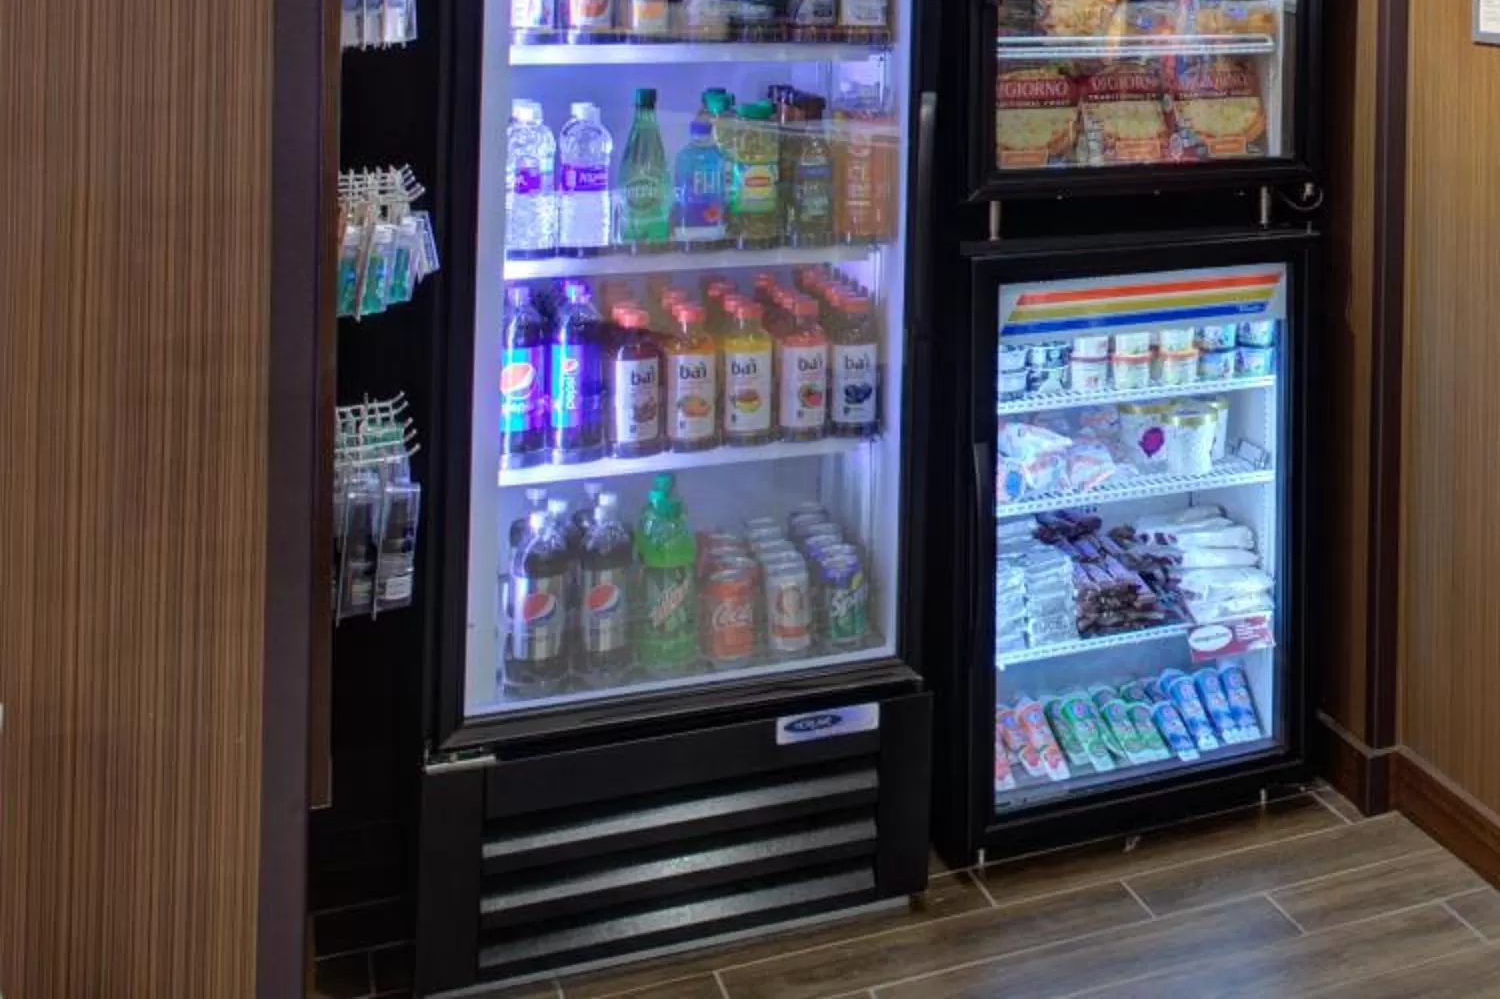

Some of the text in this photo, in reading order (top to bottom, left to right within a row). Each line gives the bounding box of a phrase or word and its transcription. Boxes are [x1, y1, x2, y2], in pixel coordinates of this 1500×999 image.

[680, 361, 707, 380] bai
[731, 357, 757, 376] bai
[844, 352, 870, 371] bai
